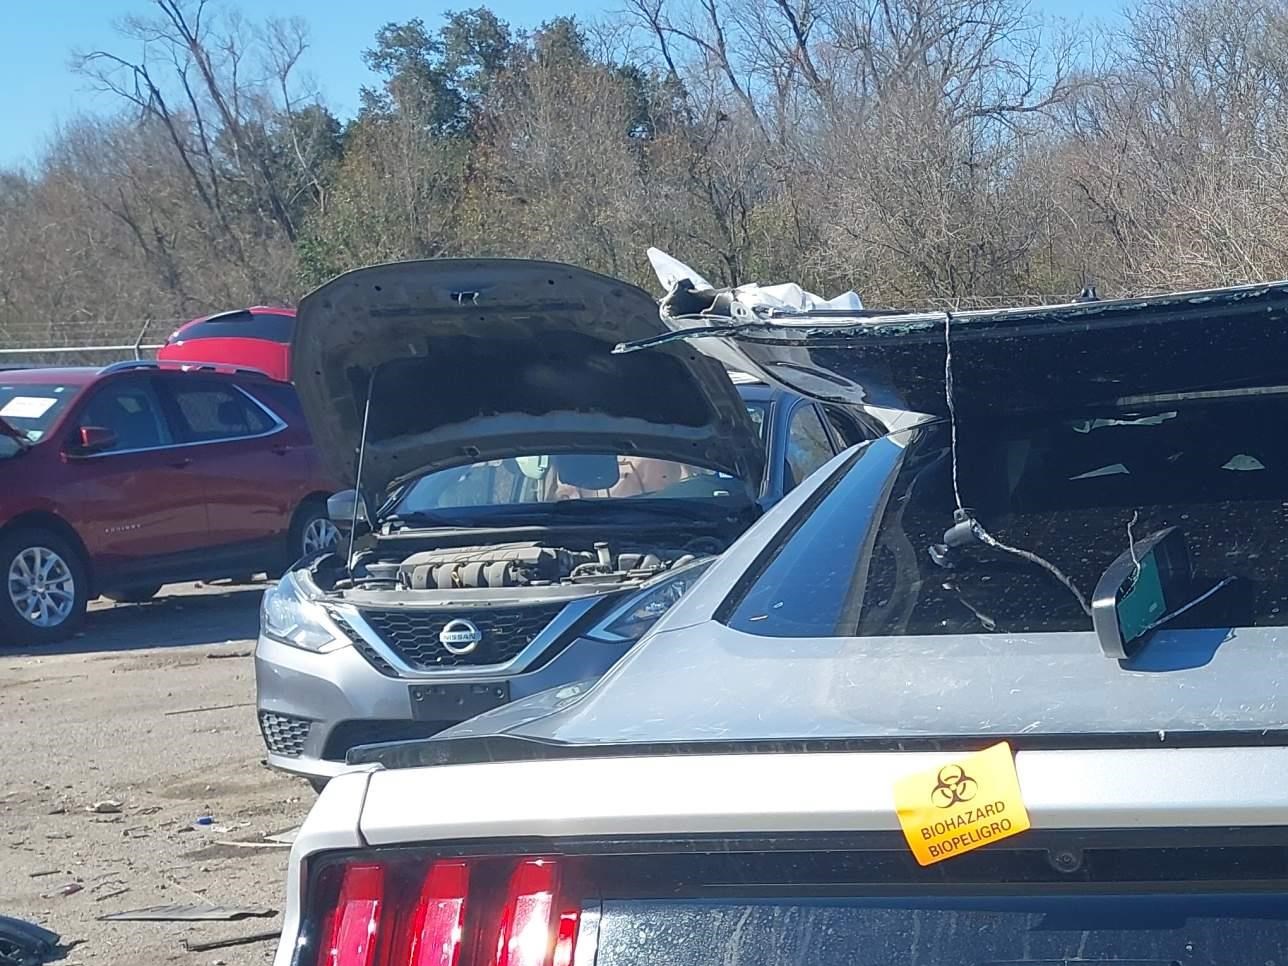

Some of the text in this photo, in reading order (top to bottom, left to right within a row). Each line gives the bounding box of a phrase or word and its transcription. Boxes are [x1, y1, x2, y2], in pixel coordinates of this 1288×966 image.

[443, 633, 476, 641] NISSAN
[920, 800, 1006, 841] BIOHAZARD
[928, 818, 1012, 858] BIOPELIGRO
